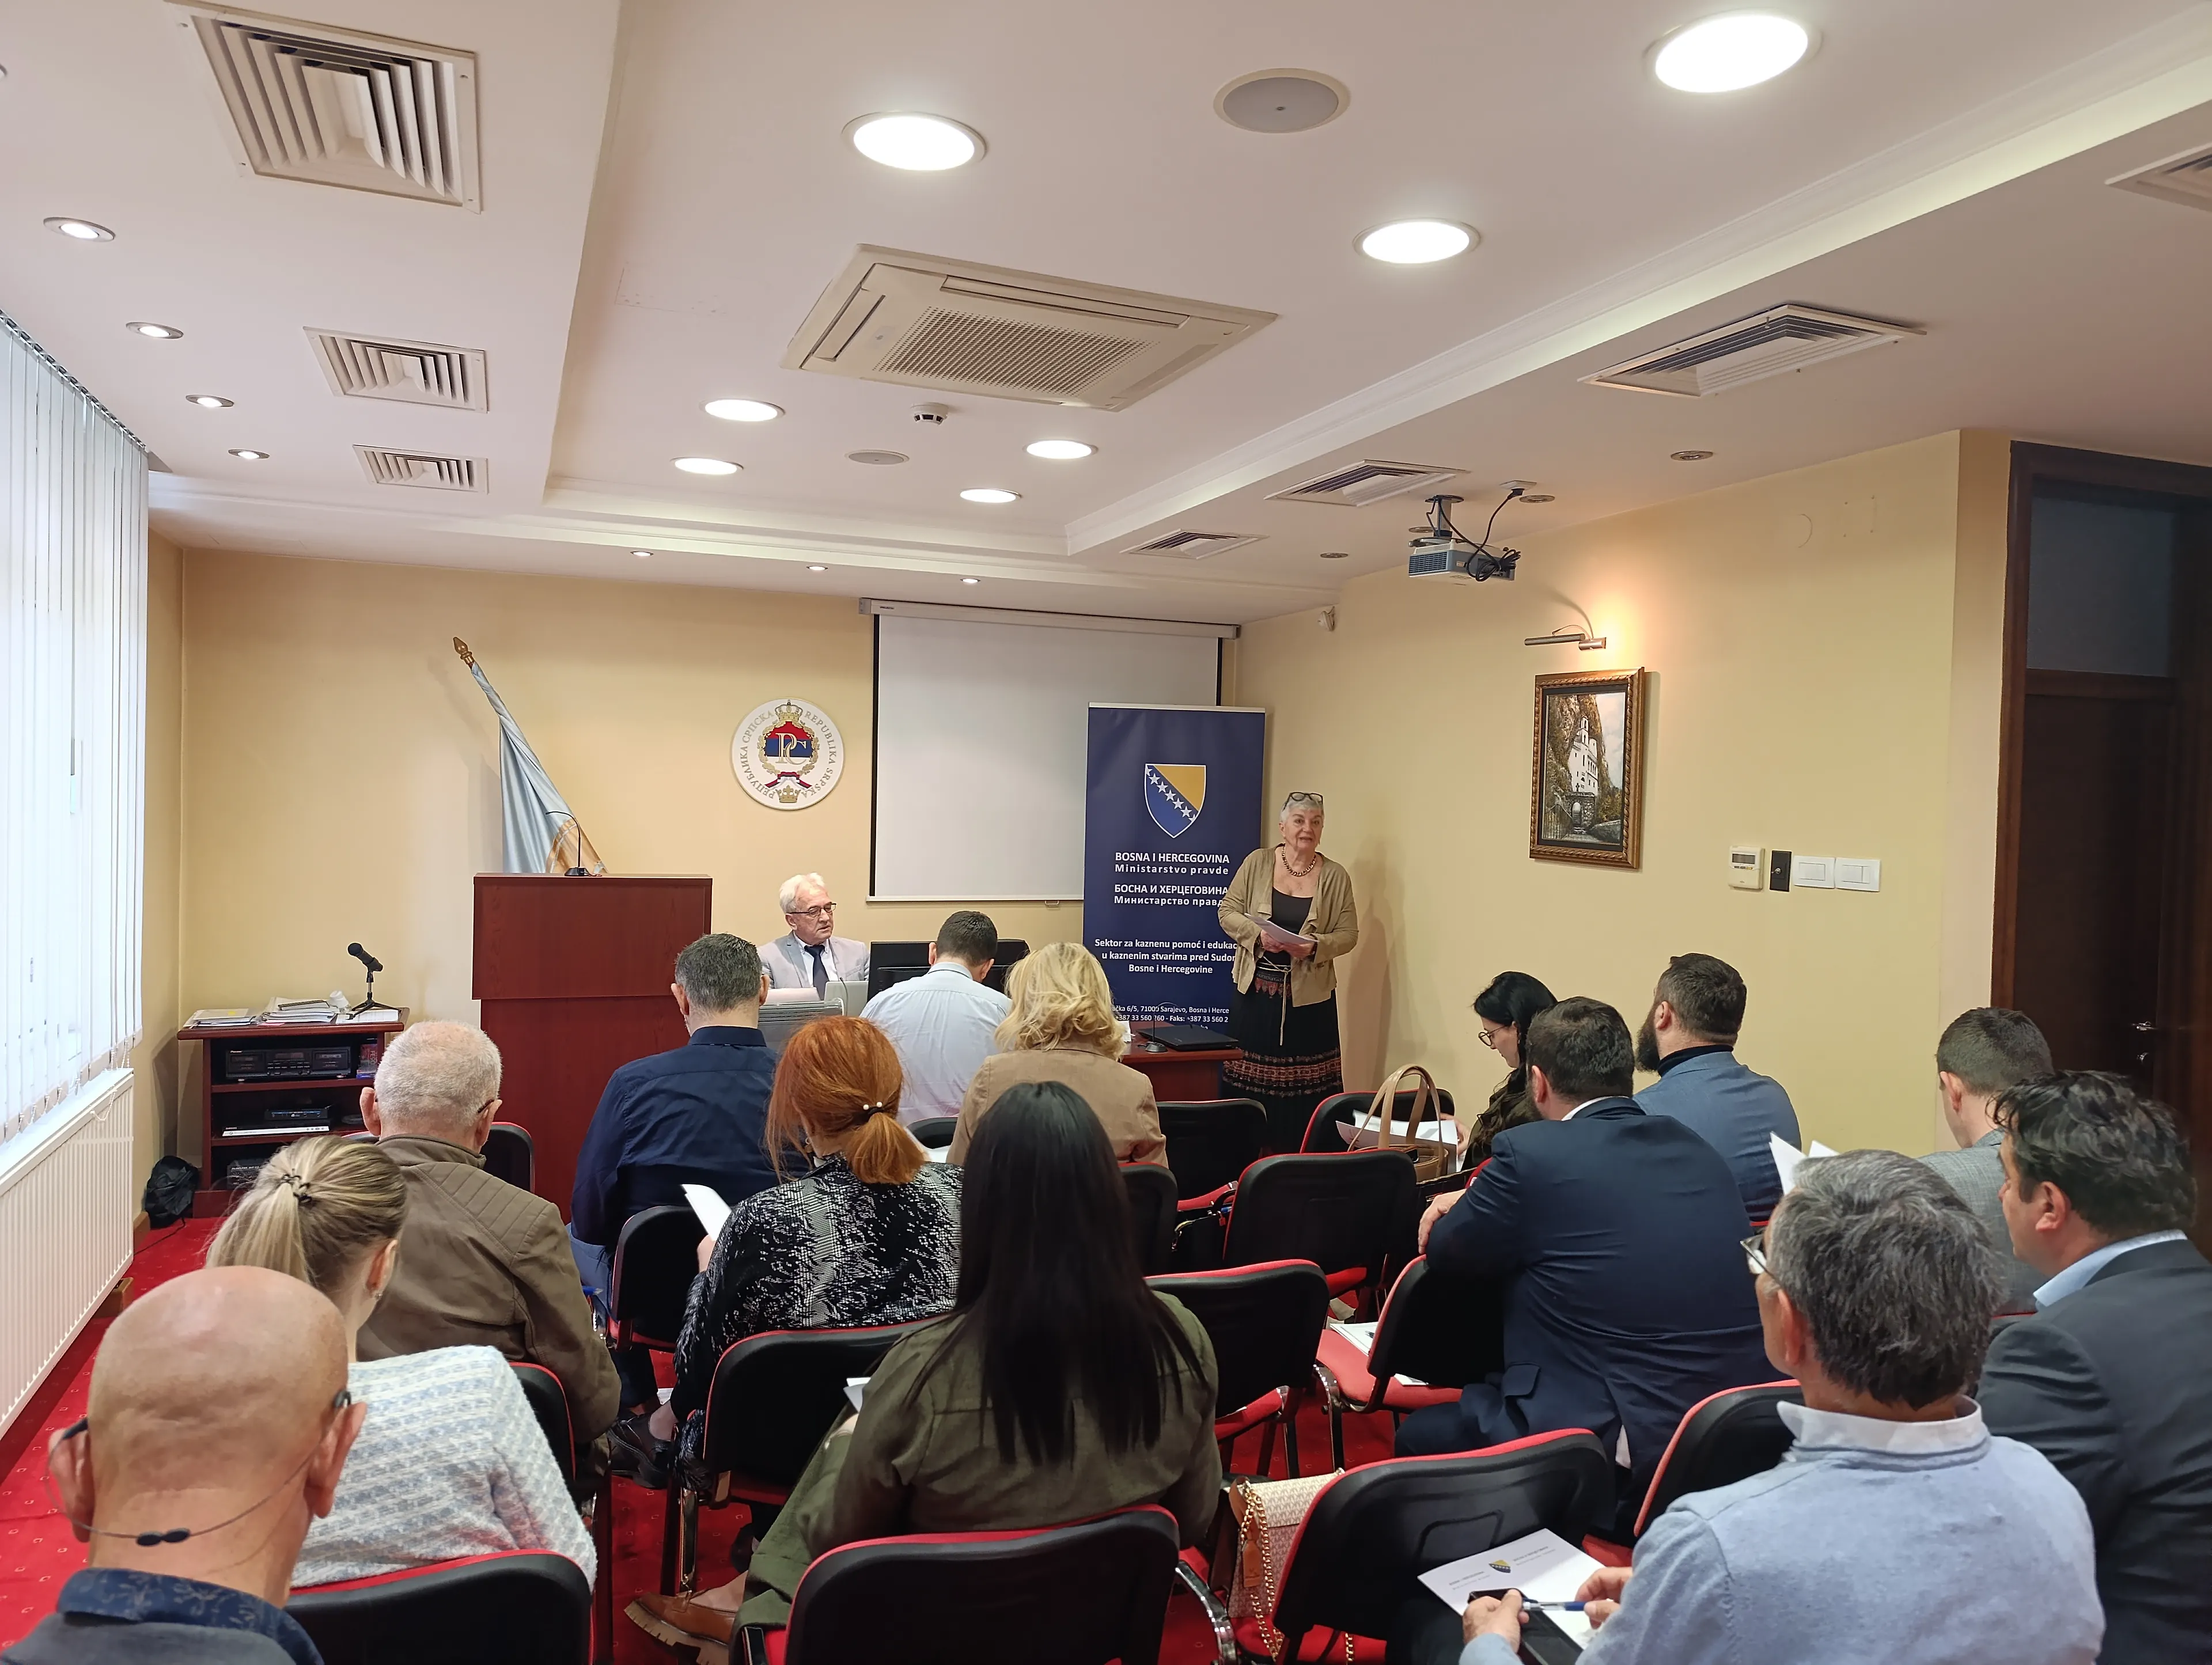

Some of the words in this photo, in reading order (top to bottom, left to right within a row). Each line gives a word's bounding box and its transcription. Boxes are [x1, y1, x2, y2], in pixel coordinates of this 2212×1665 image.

[742, 710, 774, 743] СРПСКА
[804, 710, 836, 764] REPUBLIKA
[740, 746, 775, 799] РЕПУБЛИКА
[801, 768, 833, 798] SRPSKA
[1115, 852, 1150, 862] BOSNA
[1153, 853, 1156, 862] I
[1158, 854, 1230, 864] HERCEGOVINA
[1115, 864, 1187, 874] Ministarstvo
[1190, 866, 1229, 875] pravde
[1115, 884, 1147, 893] БОСНА
[1150, 885, 1157, 894] И
[1160, 885, 1228, 896] ХЕРЦЕГОВИНА
[1114, 896, 1190, 906] Министарство
[1192, 898, 1222, 907] правд
[1094, 939, 1122, 947] Sektor
[1135, 940, 1170, 949] kaznenu
[1172, 940, 1201, 950] pomoć
[1109, 951, 1149, 960] kaznenim
[1190, 953, 1209, 962] pred
[1161, 965, 1213, 974] Hercegovine
